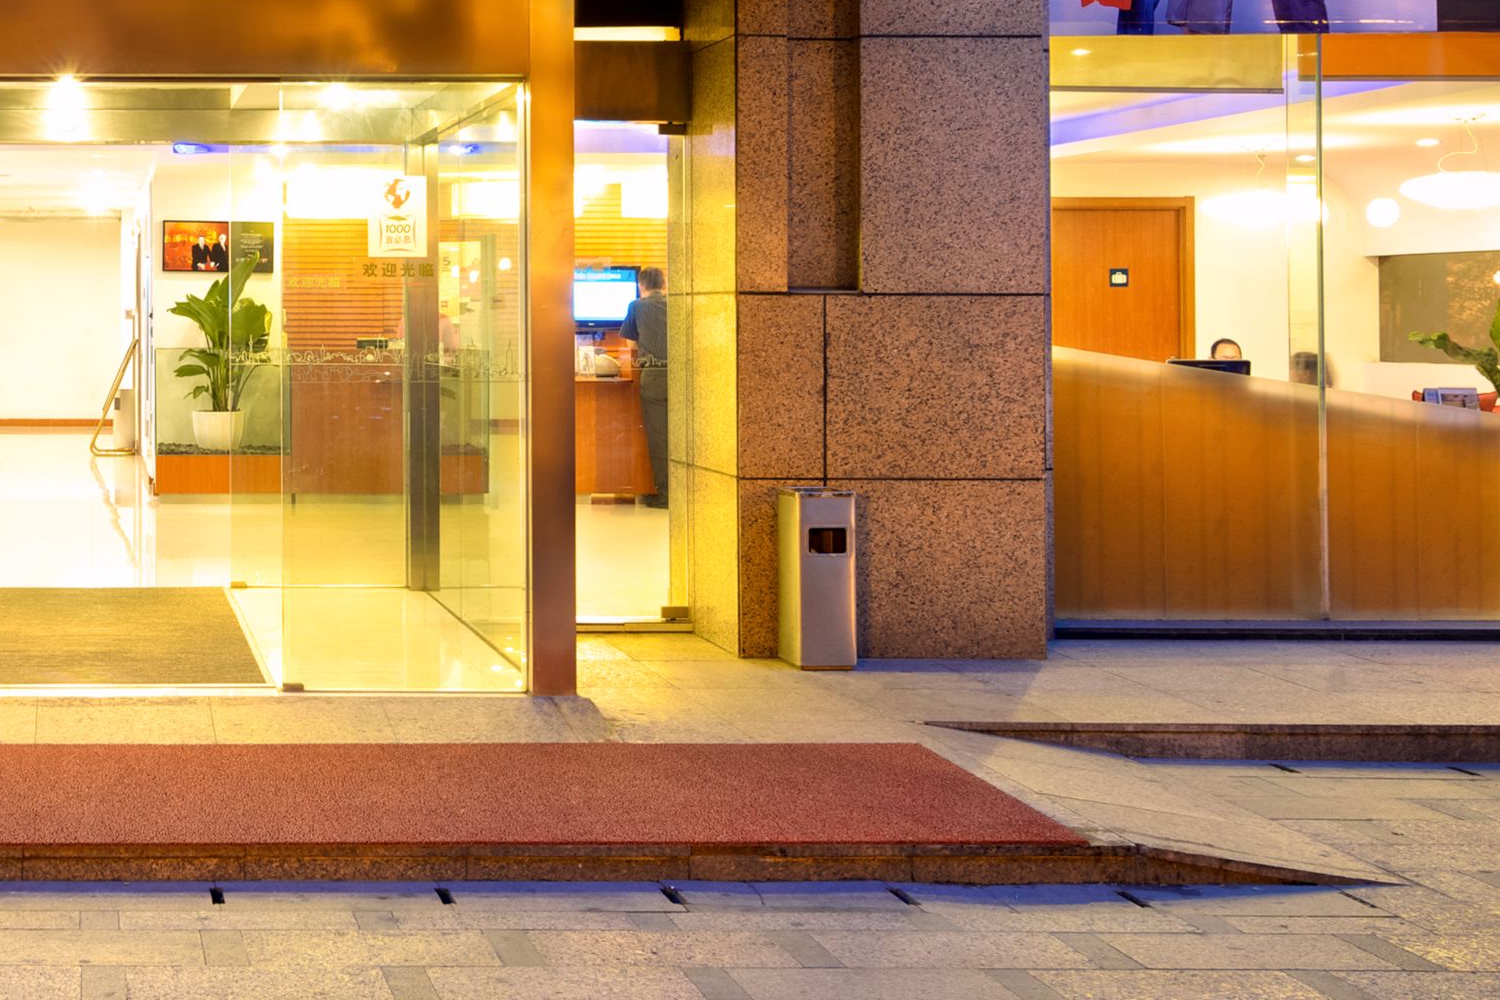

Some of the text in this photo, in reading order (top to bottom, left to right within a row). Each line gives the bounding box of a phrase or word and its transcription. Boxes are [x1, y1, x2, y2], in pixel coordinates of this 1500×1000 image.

[386, 224, 411, 234] 1000
[363, 263, 434, 277] 欢迎光临
